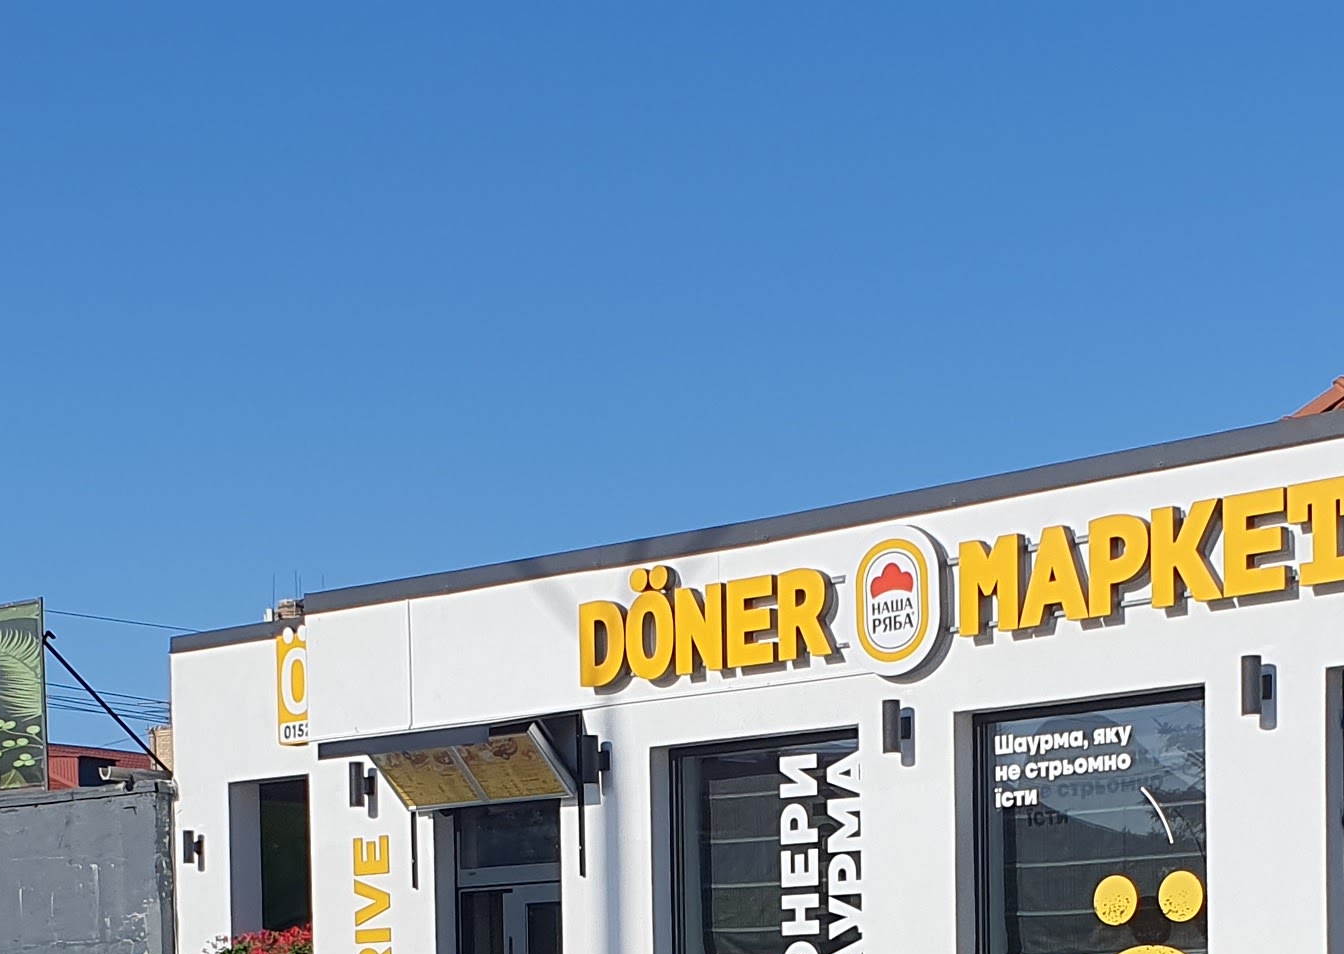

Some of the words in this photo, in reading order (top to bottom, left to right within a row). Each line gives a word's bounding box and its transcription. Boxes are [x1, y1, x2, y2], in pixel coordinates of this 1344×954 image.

[871, 597, 913, 616] НАША
[579, 565, 831, 687] DÖNER
[872, 613, 914, 634] РЯБА
[994, 730, 1089, 755] Шаурма,
[1093, 725, 1132, 747] яку
[995, 764, 1021, 781] не
[1025, 753, 1132, 780] стрьомно
[994, 789, 1038, 808] їсти
